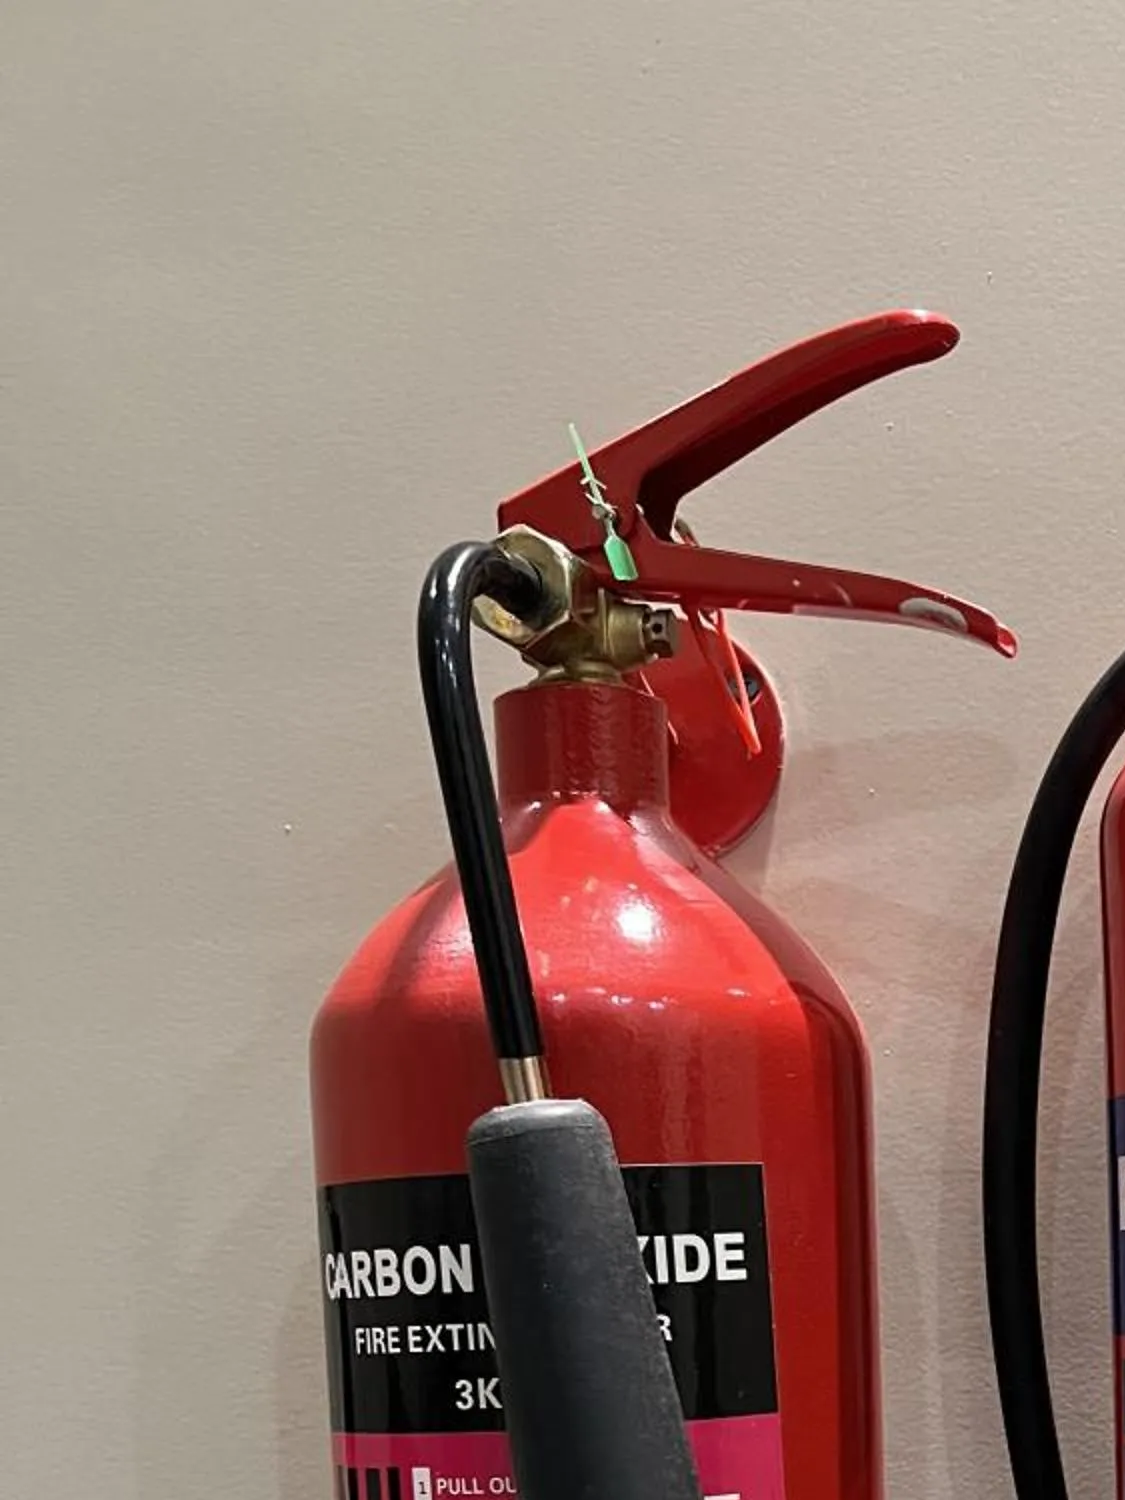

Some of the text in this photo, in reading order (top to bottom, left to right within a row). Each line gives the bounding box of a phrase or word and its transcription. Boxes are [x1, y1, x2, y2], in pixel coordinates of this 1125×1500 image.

[324, 1243, 474, 1300] CARBON
[355, 1327, 401, 1355] FIRE
[454, 1378, 503, 1411] 3K
[418, 1481, 427, 1495] 1
[436, 1477, 484, 1495] PULL
